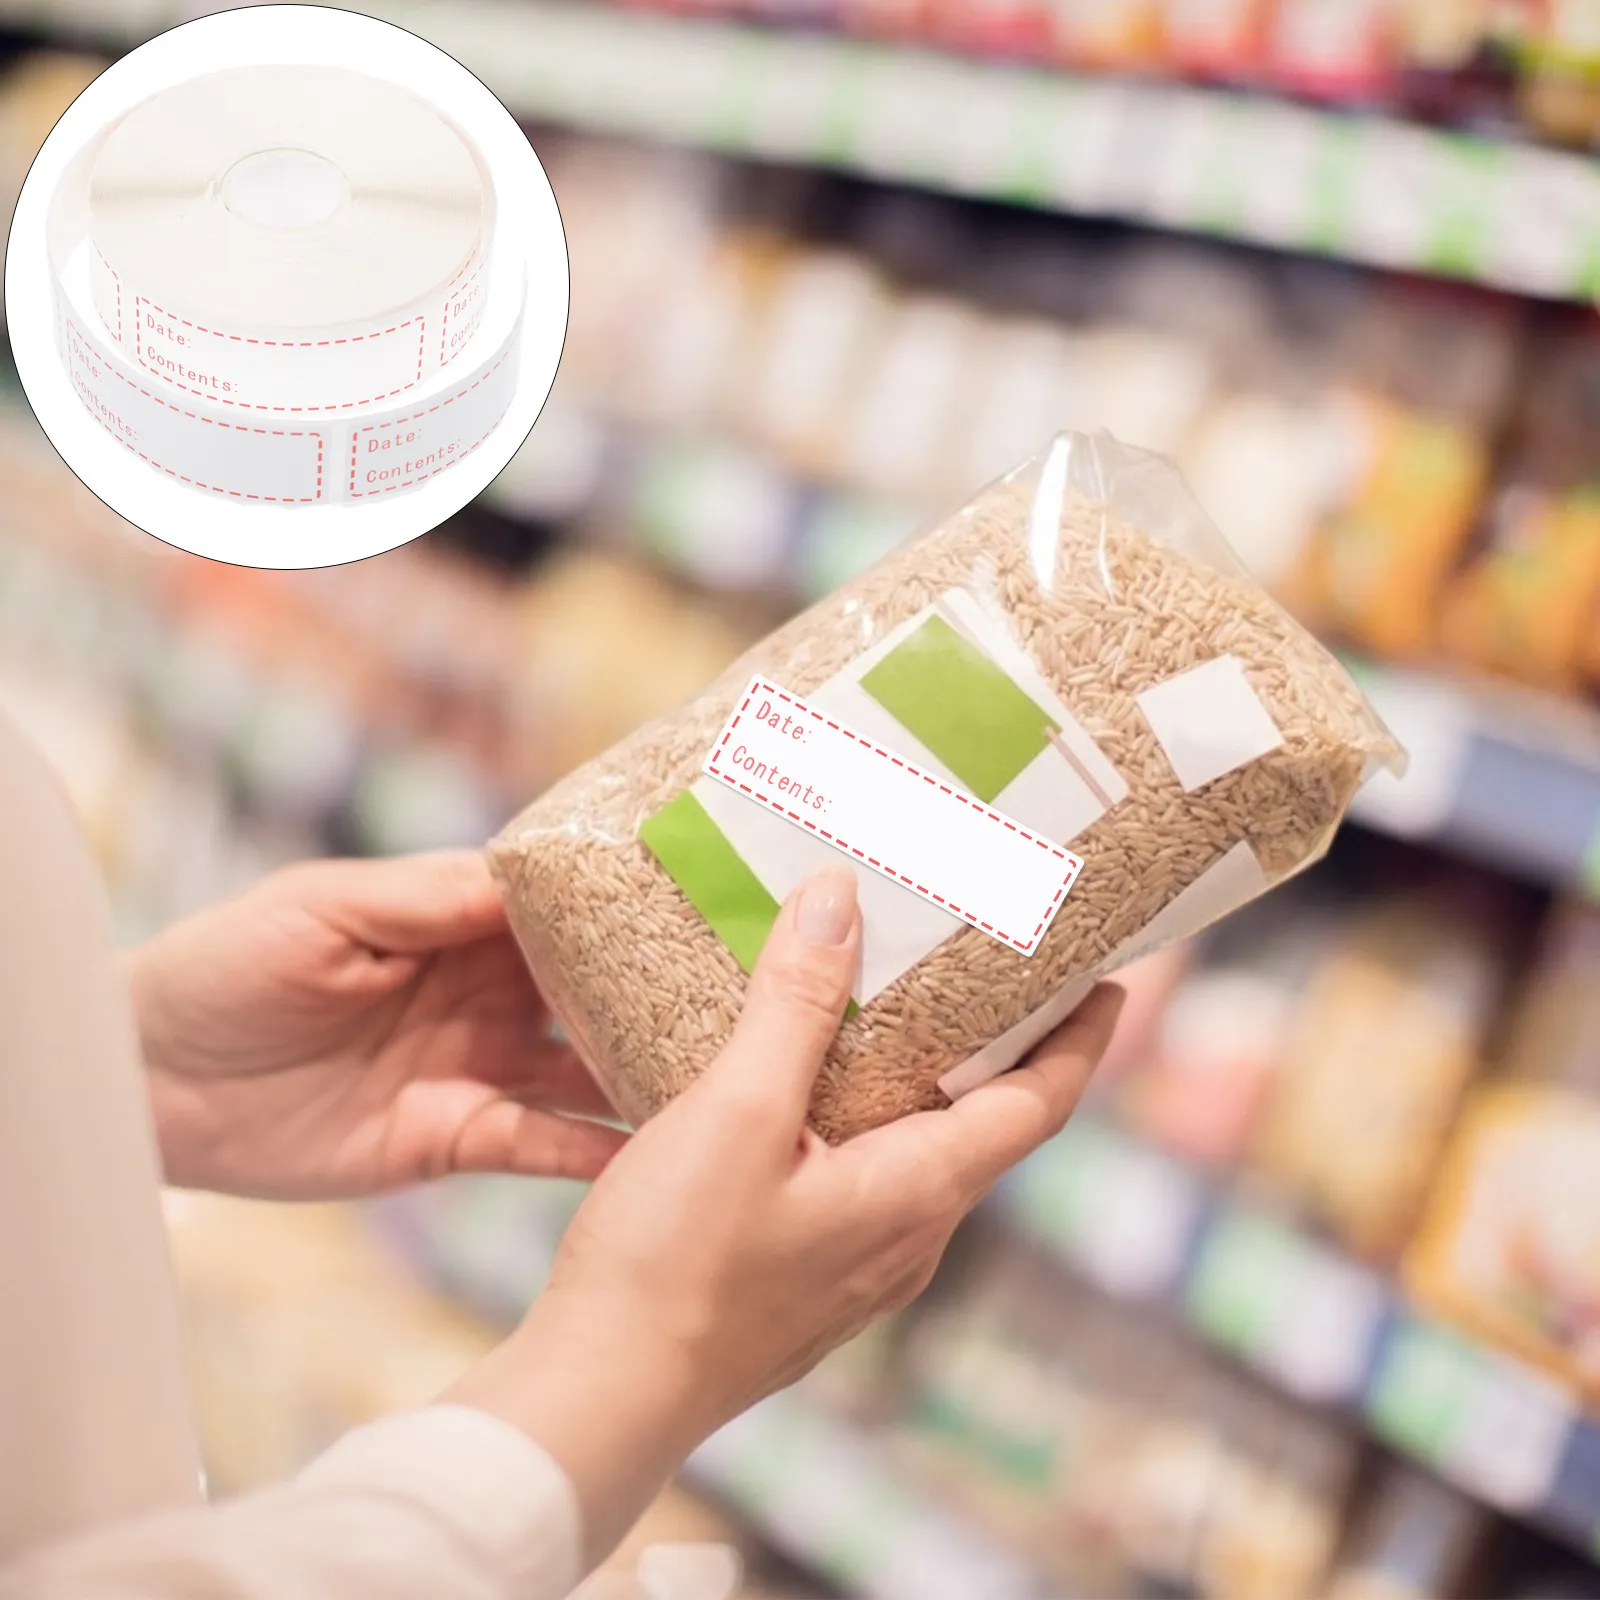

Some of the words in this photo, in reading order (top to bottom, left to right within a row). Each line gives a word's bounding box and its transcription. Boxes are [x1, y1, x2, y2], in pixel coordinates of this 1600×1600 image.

[147, 314, 192, 348] Date:
[73, 338, 103, 382] Date:
[147, 346, 239, 393] Contents:
[75, 370, 137, 441] Contents:
[366, 438, 463, 483] Contents:
[367, 428, 422, 453] Date:
[755, 700, 812, 744] Date:
[732, 745, 832, 813] Contents:
